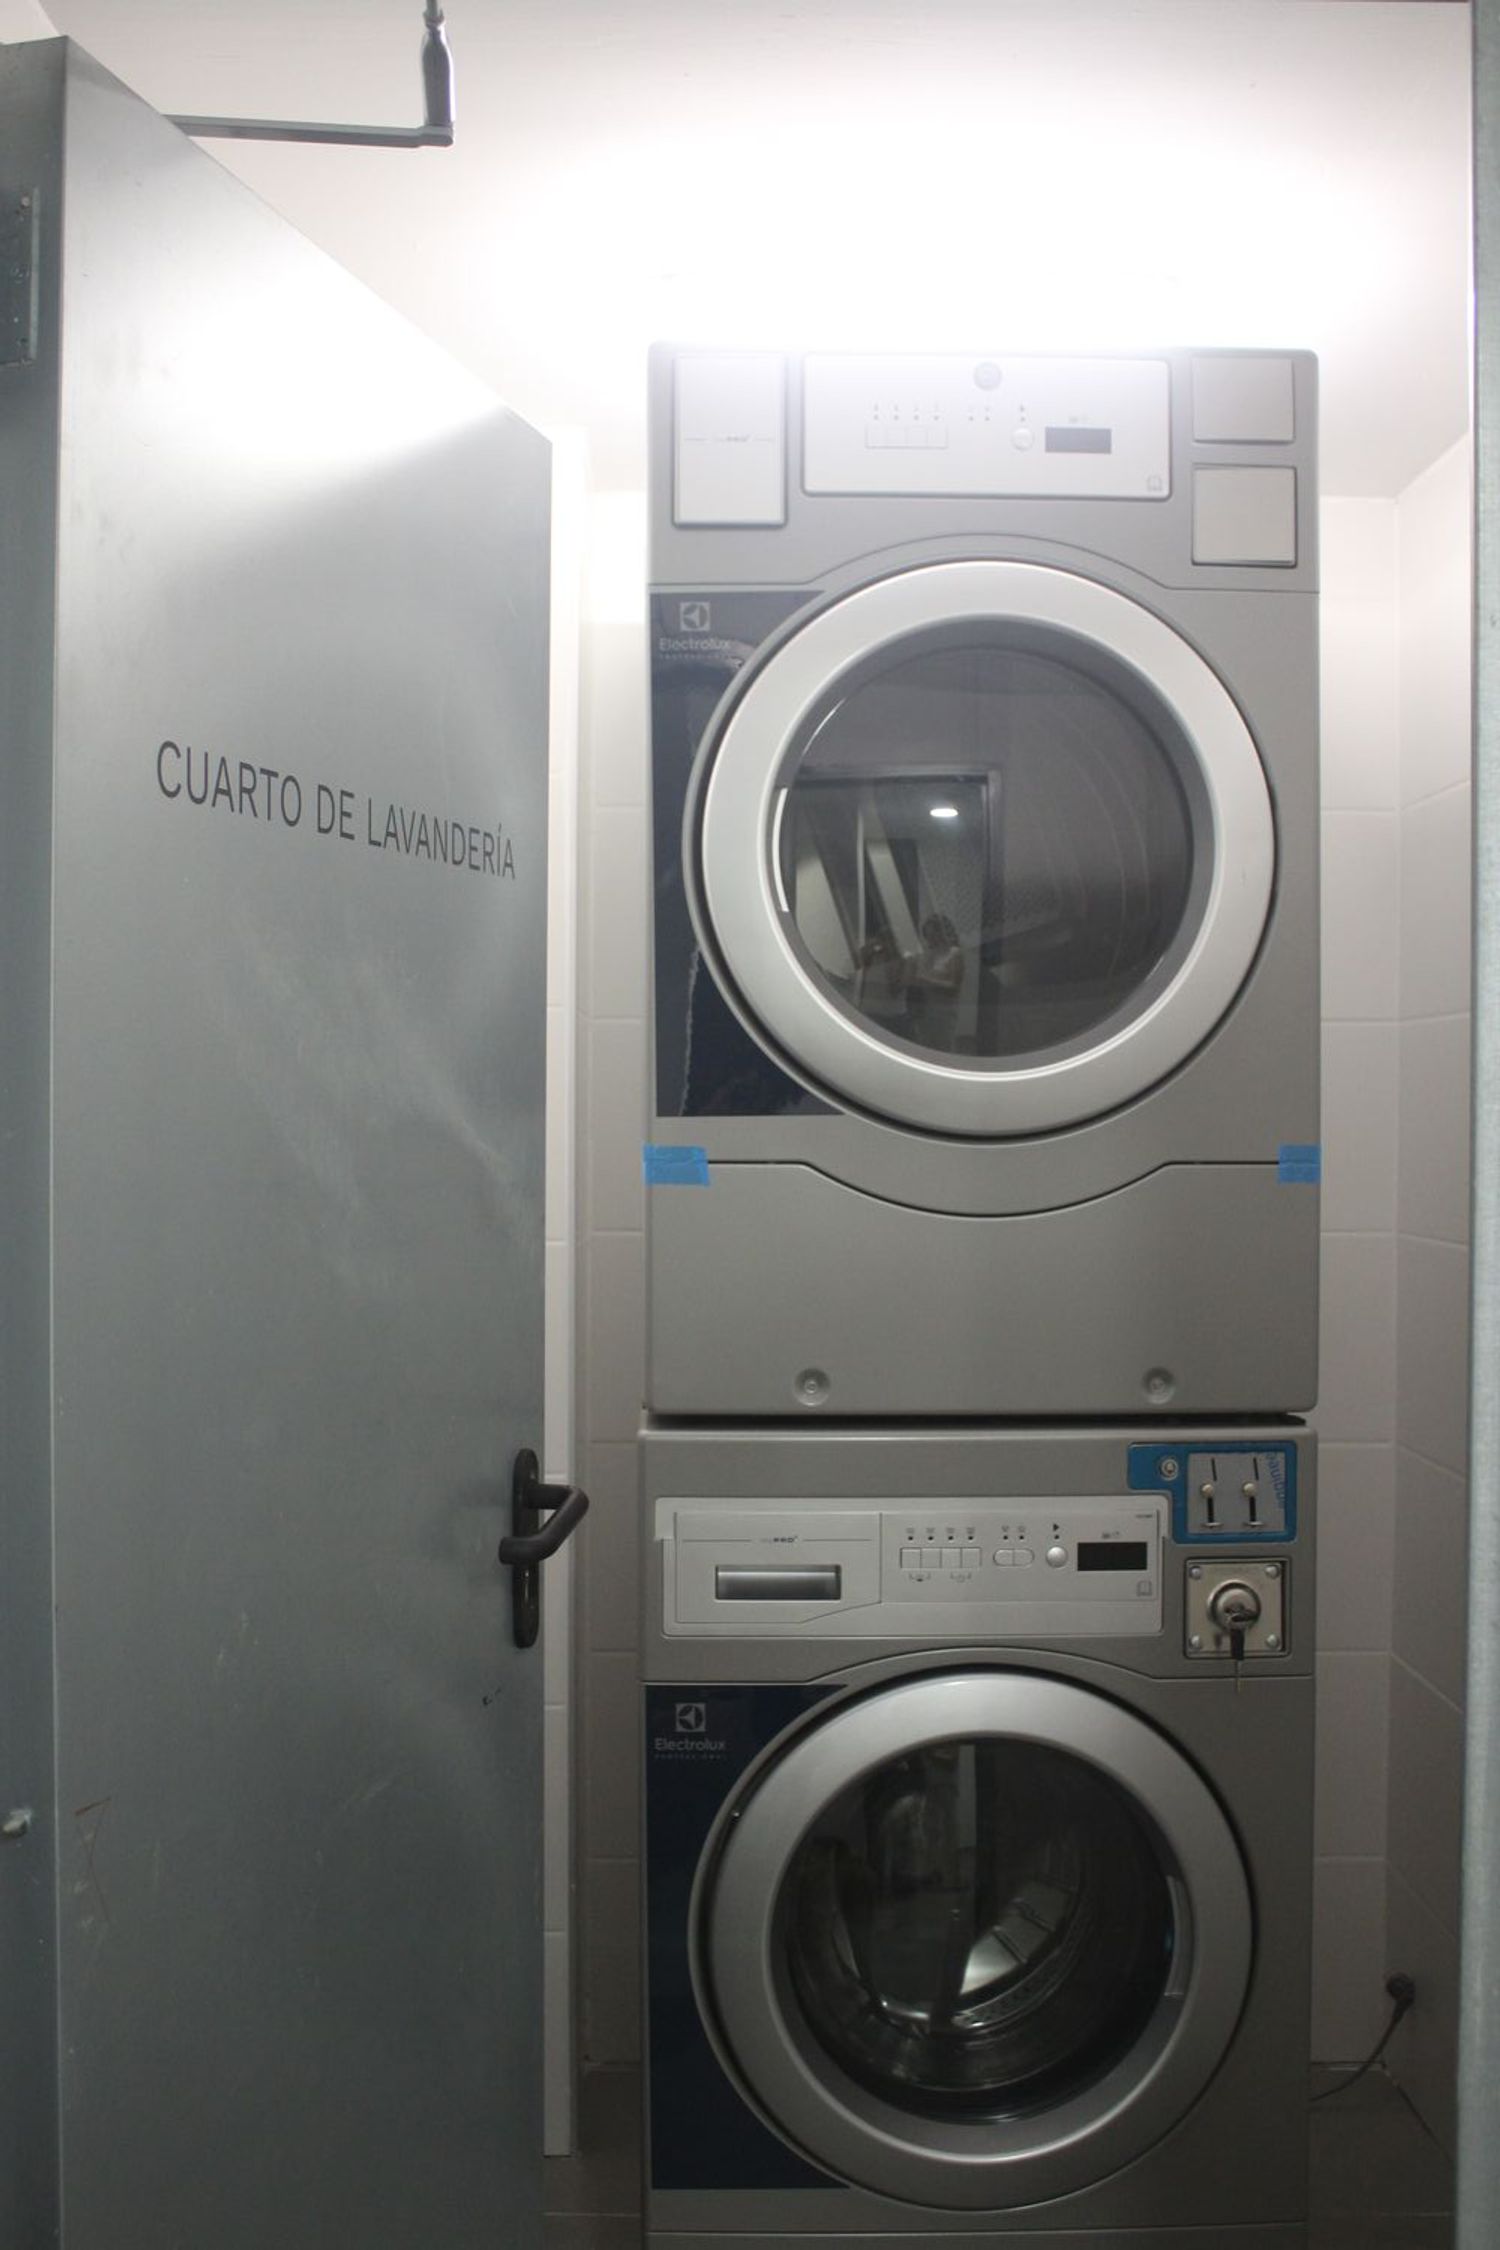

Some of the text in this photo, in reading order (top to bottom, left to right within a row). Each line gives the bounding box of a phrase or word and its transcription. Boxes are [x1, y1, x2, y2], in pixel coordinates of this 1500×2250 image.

[659, 638, 731, 650] Electrolux
[156, 740, 516, 880] CUARTO DE LAVANDERÍA
[655, 1738, 725, 1750] Electrolux
